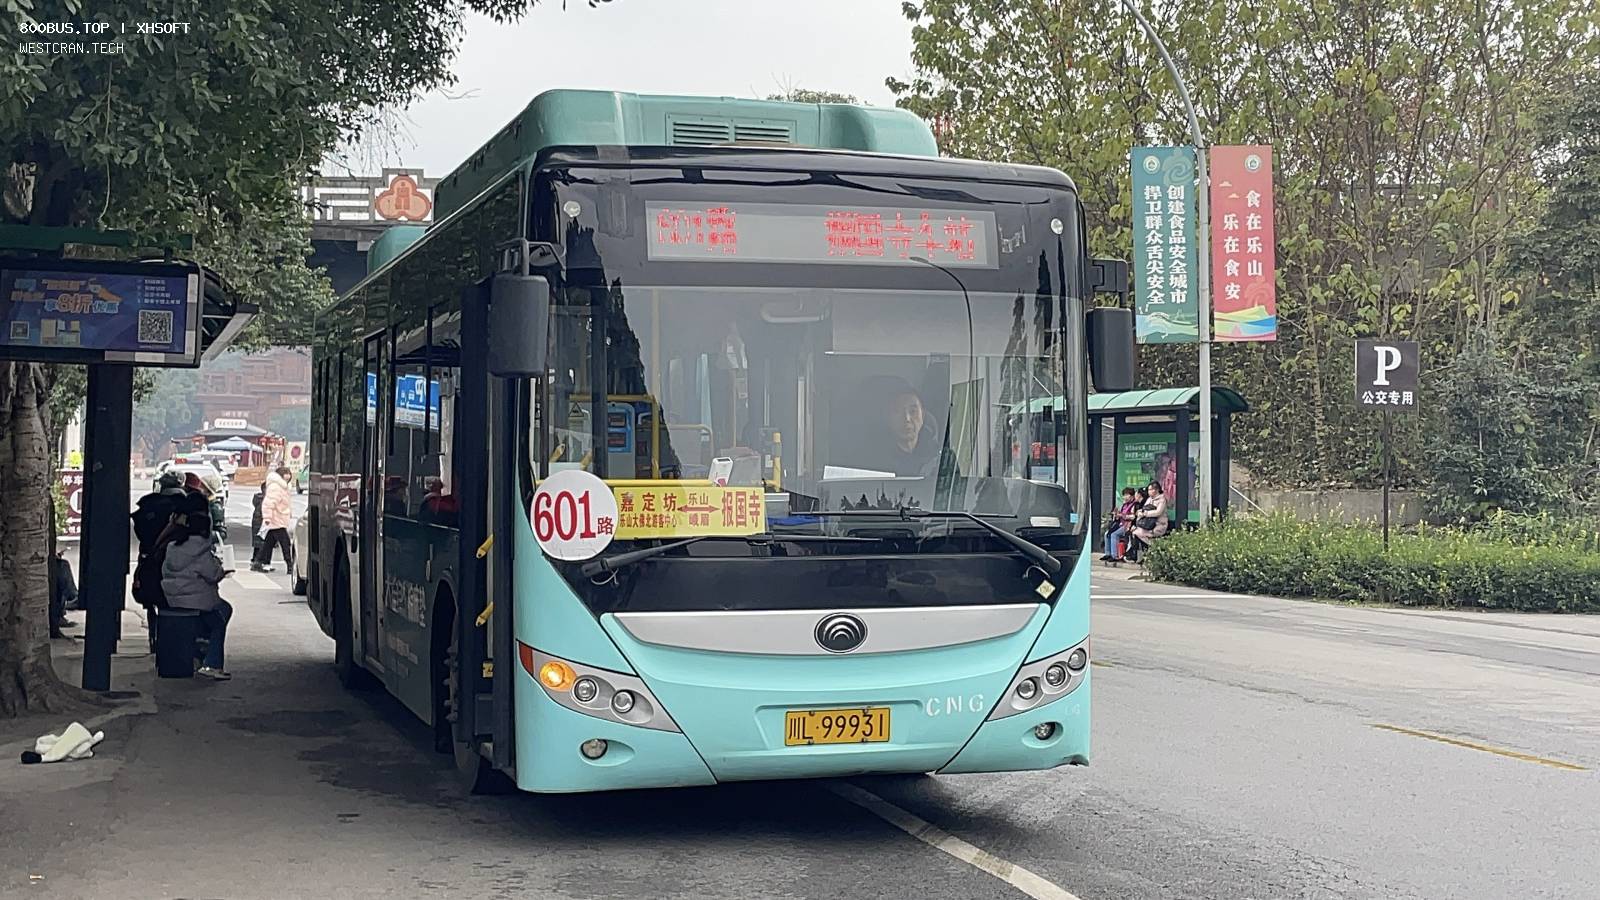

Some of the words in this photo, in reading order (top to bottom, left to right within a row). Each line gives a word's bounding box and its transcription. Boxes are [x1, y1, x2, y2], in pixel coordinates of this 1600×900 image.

[1143, 185, 1165, 305] 捍卫群众舌尖安全
[1166, 184, 1188, 304] 创建食品安全城市
[1245, 189, 1263, 277] 食在乐山
[1223, 213, 1241, 301] 乐在食安
[1372, 345, 1402, 386] P
[1361, 390, 1413, 406] 公交专用
[620, 491, 678, 512] 嘉定坊
[688, 492, 709, 506] 乐山
[721, 490, 761, 528] 报国寺
[926, 694, 984, 717] CNG
